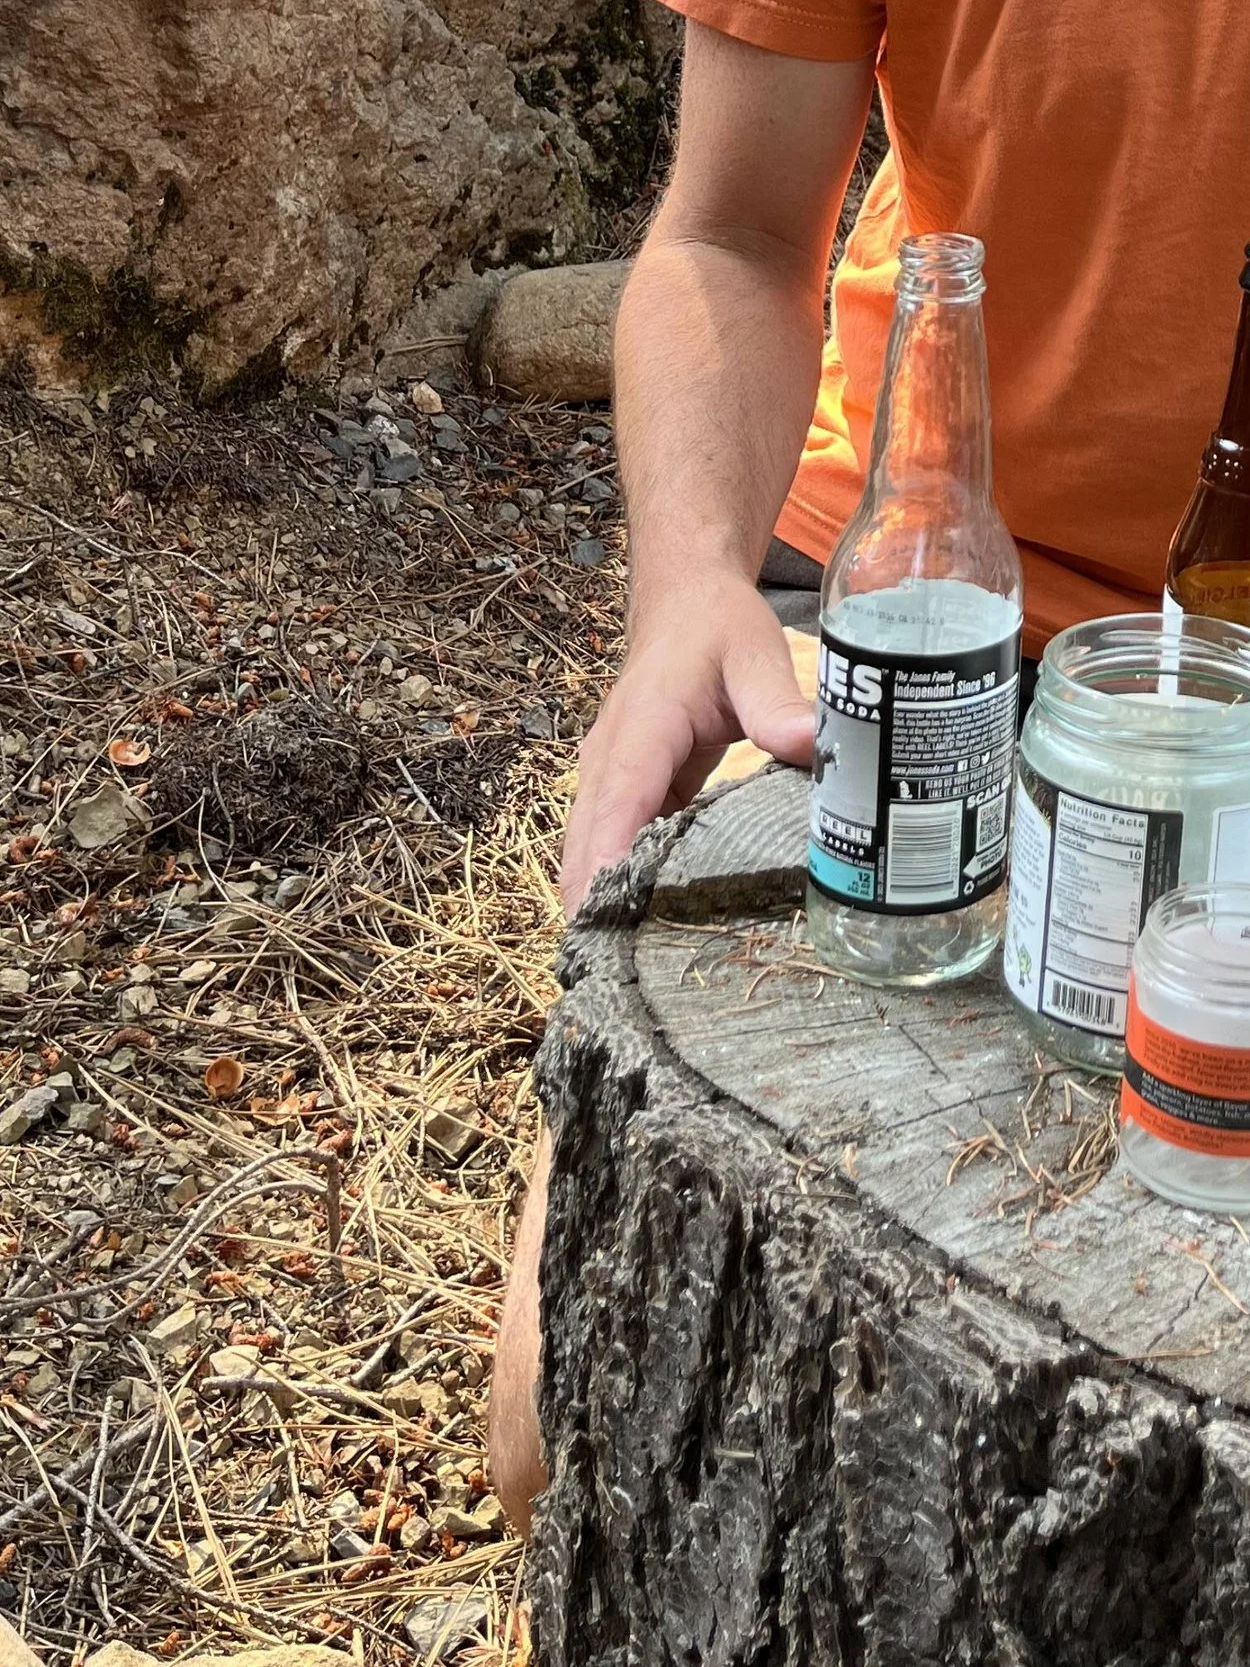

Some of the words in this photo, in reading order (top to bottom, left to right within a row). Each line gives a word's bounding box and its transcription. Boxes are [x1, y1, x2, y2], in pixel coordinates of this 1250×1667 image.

[895, 670, 908, 682] The
[931, 670, 956, 683] Family
[894, 682, 955, 701] Independent
[956, 680, 981, 696] Since
[837, 698, 881, 720] SODA
[966, 782, 1000, 809] SCAN
[1060, 797, 1106, 822] Nutrition
[1112, 814, 1145, 828] Facts
[823, 815, 867, 840] REEL
[823, 832, 865, 856] LABELS
[1058, 832, 1087, 850] Calories
[1128, 850, 1142, 861] 10
[857, 871, 871, 882] 12
[1192, 1094, 1212, 1107] layer
[1213, 1100, 1222, 1110] of
[1224, 1101, 1247, 1111] flavor
[1225, 1110, 1242, 1119] fish,
